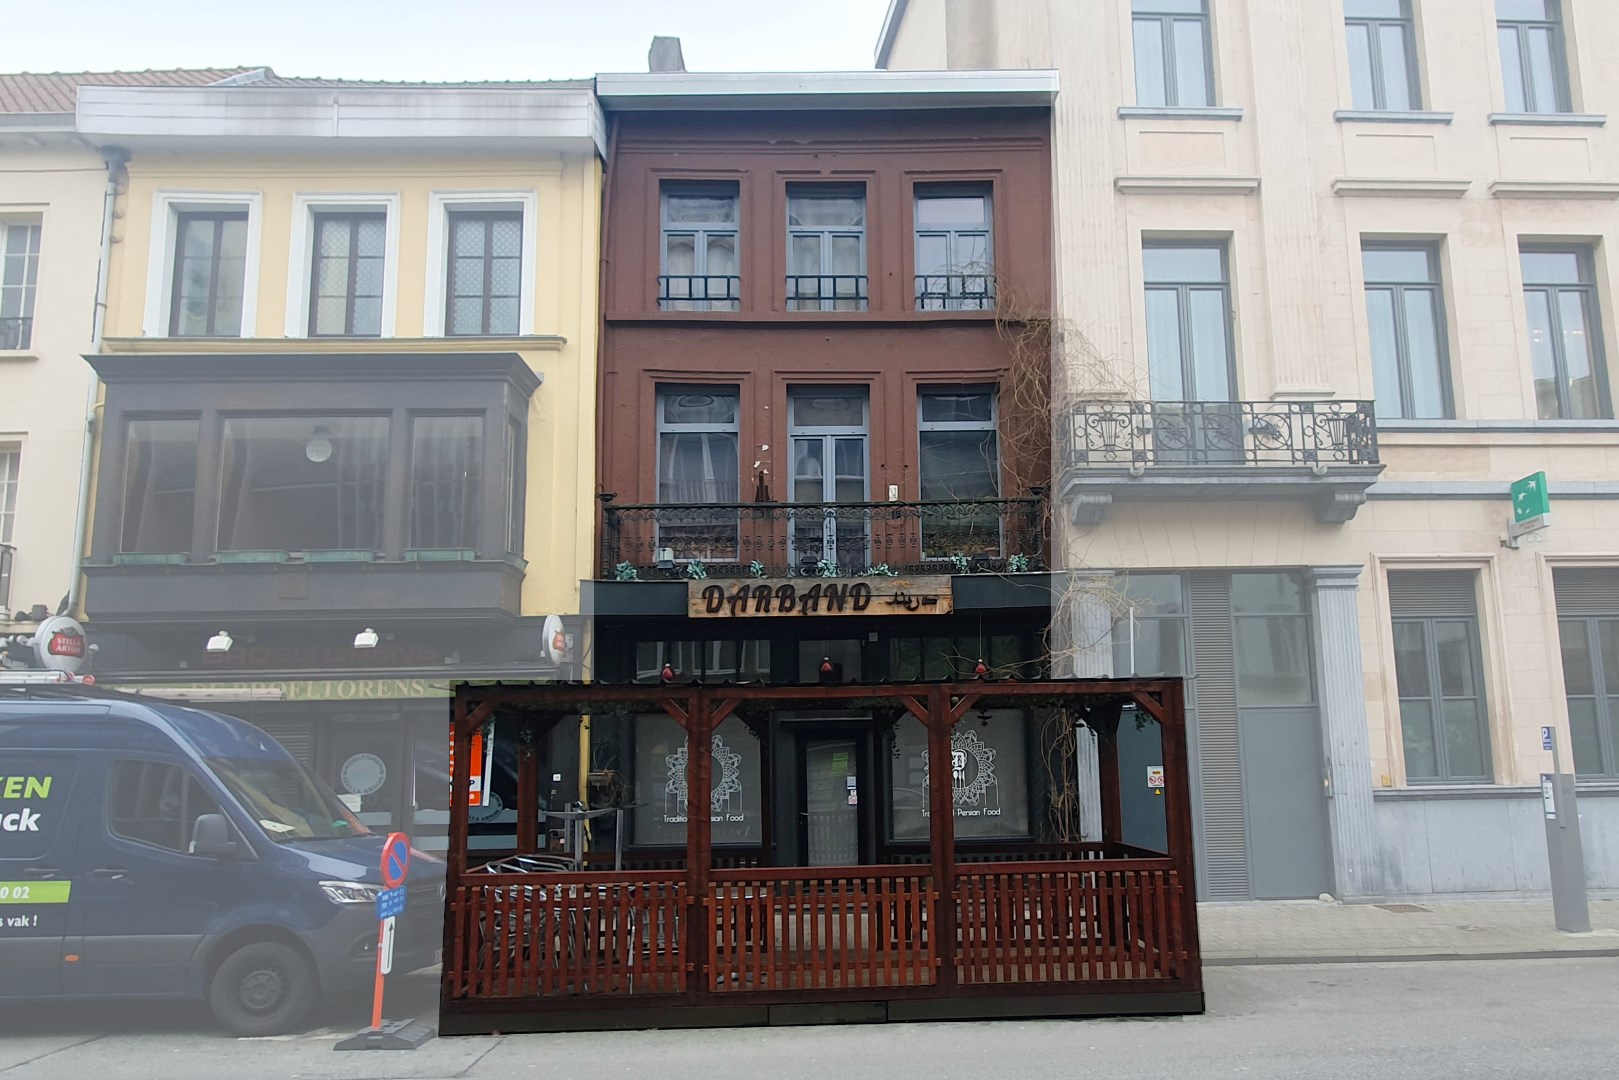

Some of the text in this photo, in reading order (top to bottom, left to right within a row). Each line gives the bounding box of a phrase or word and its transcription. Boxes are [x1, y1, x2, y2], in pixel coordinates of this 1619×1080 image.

[702, 582, 872, 616] DARBAND
[57, 637, 81, 646] STELLA
[0, 776, 52, 798] EN
[726, 813, 743, 821] Food
[983, 807, 1001, 816] Food
[0, 808, 41, 831] ck
[13, 886, 30, 899] 02
[7, 914, 30, 927] vak
